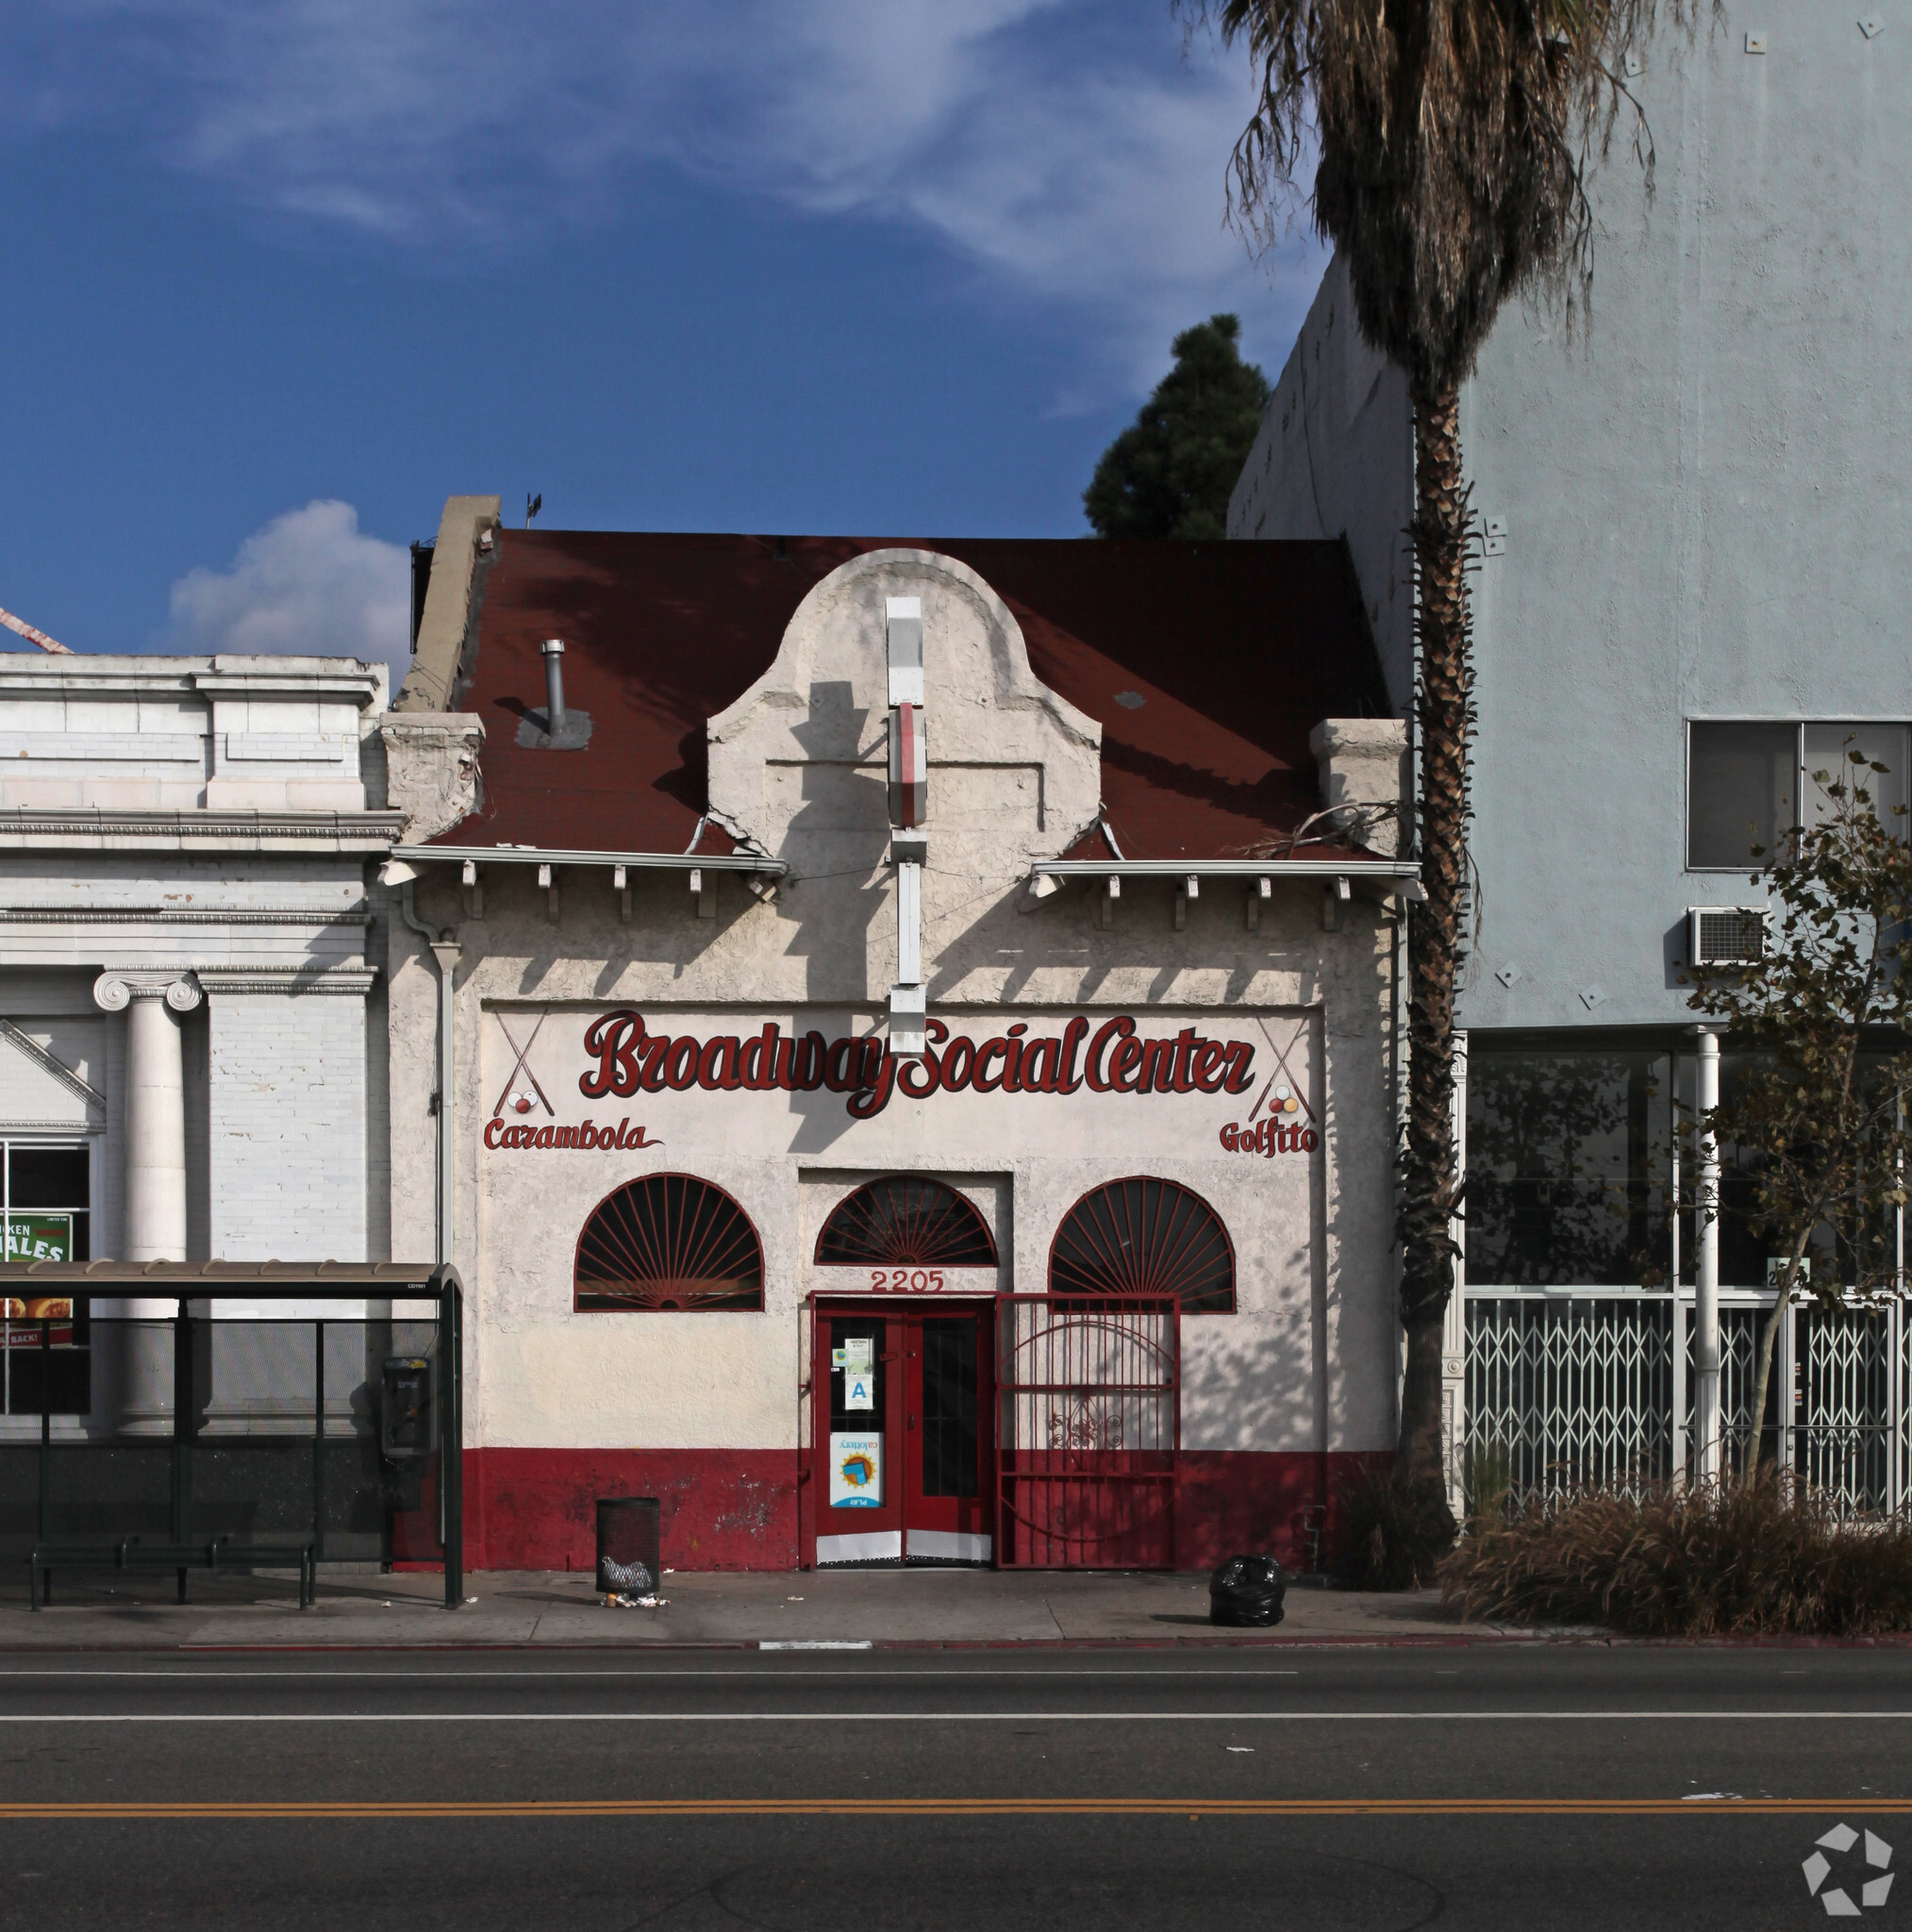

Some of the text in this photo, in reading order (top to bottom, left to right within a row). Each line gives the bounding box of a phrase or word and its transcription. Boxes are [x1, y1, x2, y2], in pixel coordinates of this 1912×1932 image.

[579, 1009, 1255, 1119] Broadway Social Center
[483, 1117, 665, 1150] Carambola
[1219, 1116, 1319, 1158] Golfito
[872, 1270, 943, 1291] 2205
[10, 1334, 38, 1343] BACK!
[851, 1381, 867, 1398] A
[840, 1440, 878, 1451] calottery
